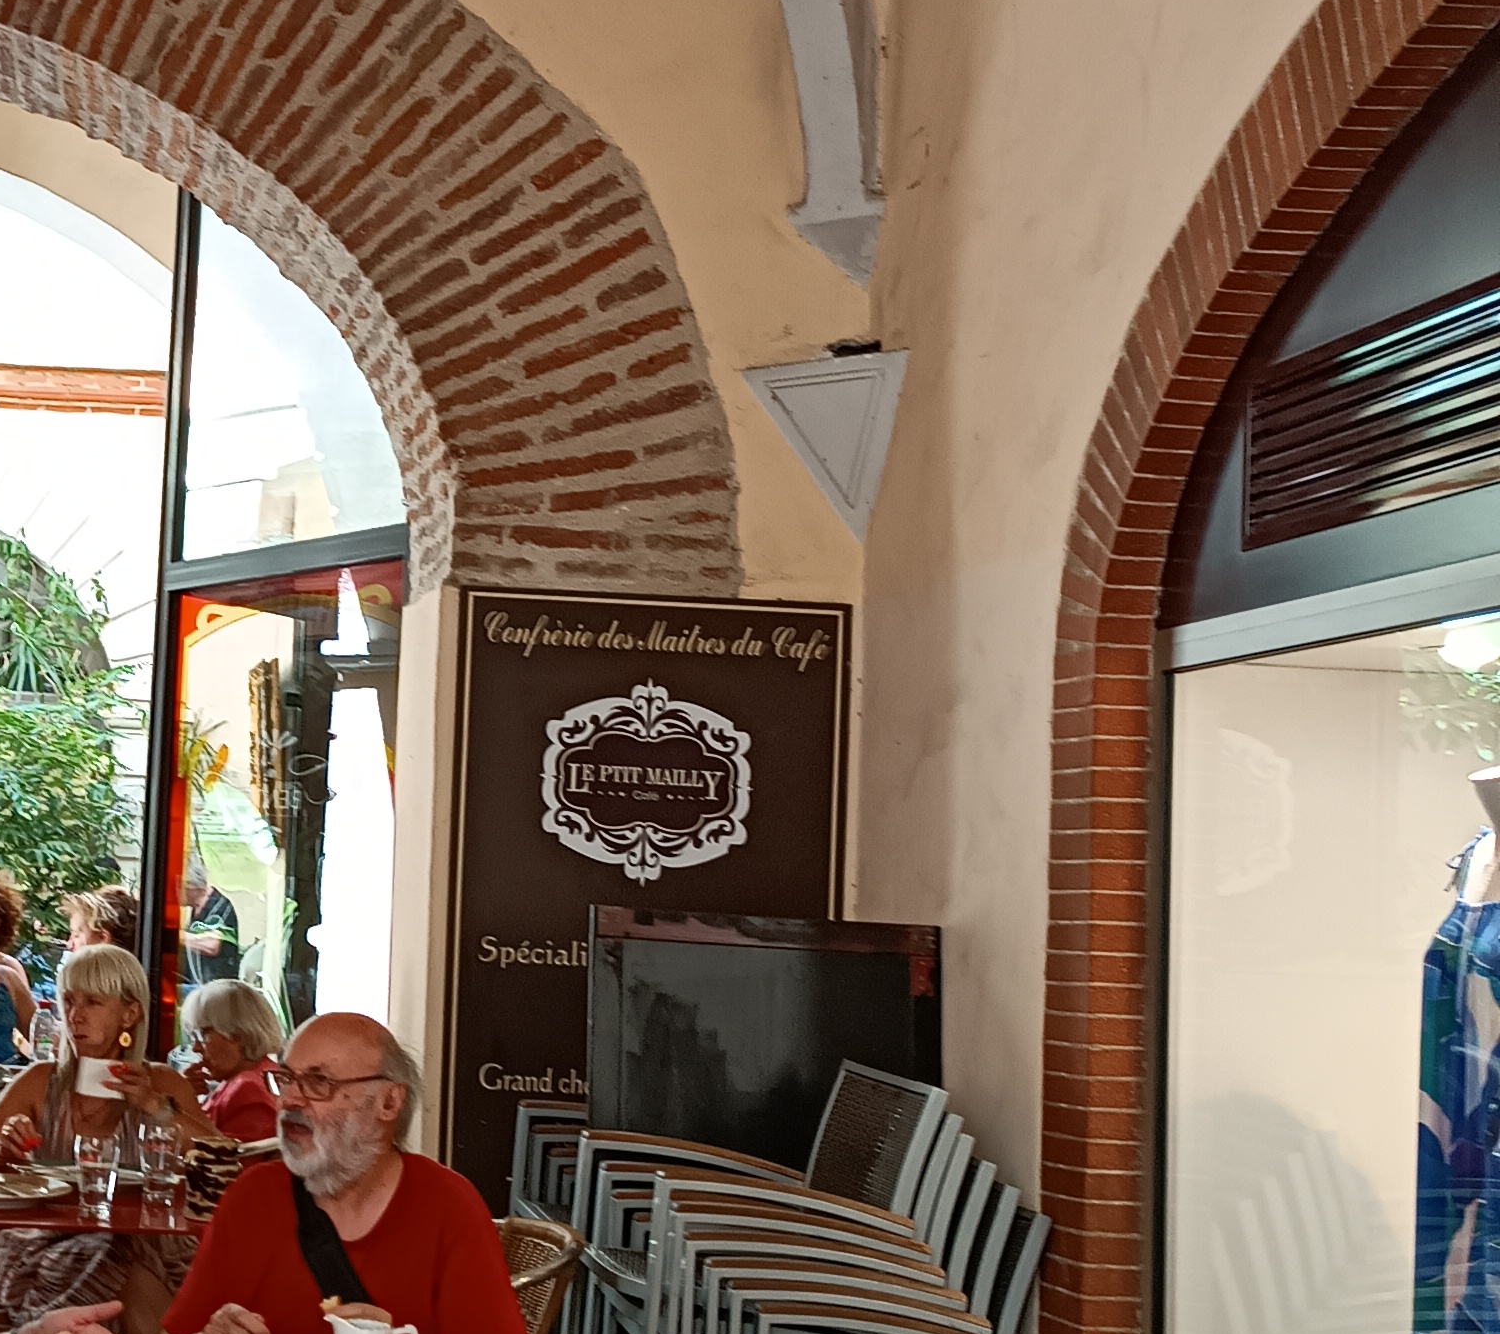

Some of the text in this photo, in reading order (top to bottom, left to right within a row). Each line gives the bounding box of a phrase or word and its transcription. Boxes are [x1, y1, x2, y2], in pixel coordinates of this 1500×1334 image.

[597, 620, 634, 650] des
[731, 627, 763, 656] du
[771, 626, 832, 672] Café
[566, 762, 596, 794] LE
[645, 766, 725, 801] MAILLY
[478, 935, 588, 969] Spéciali
[479, 1063, 553, 1093] Grand
